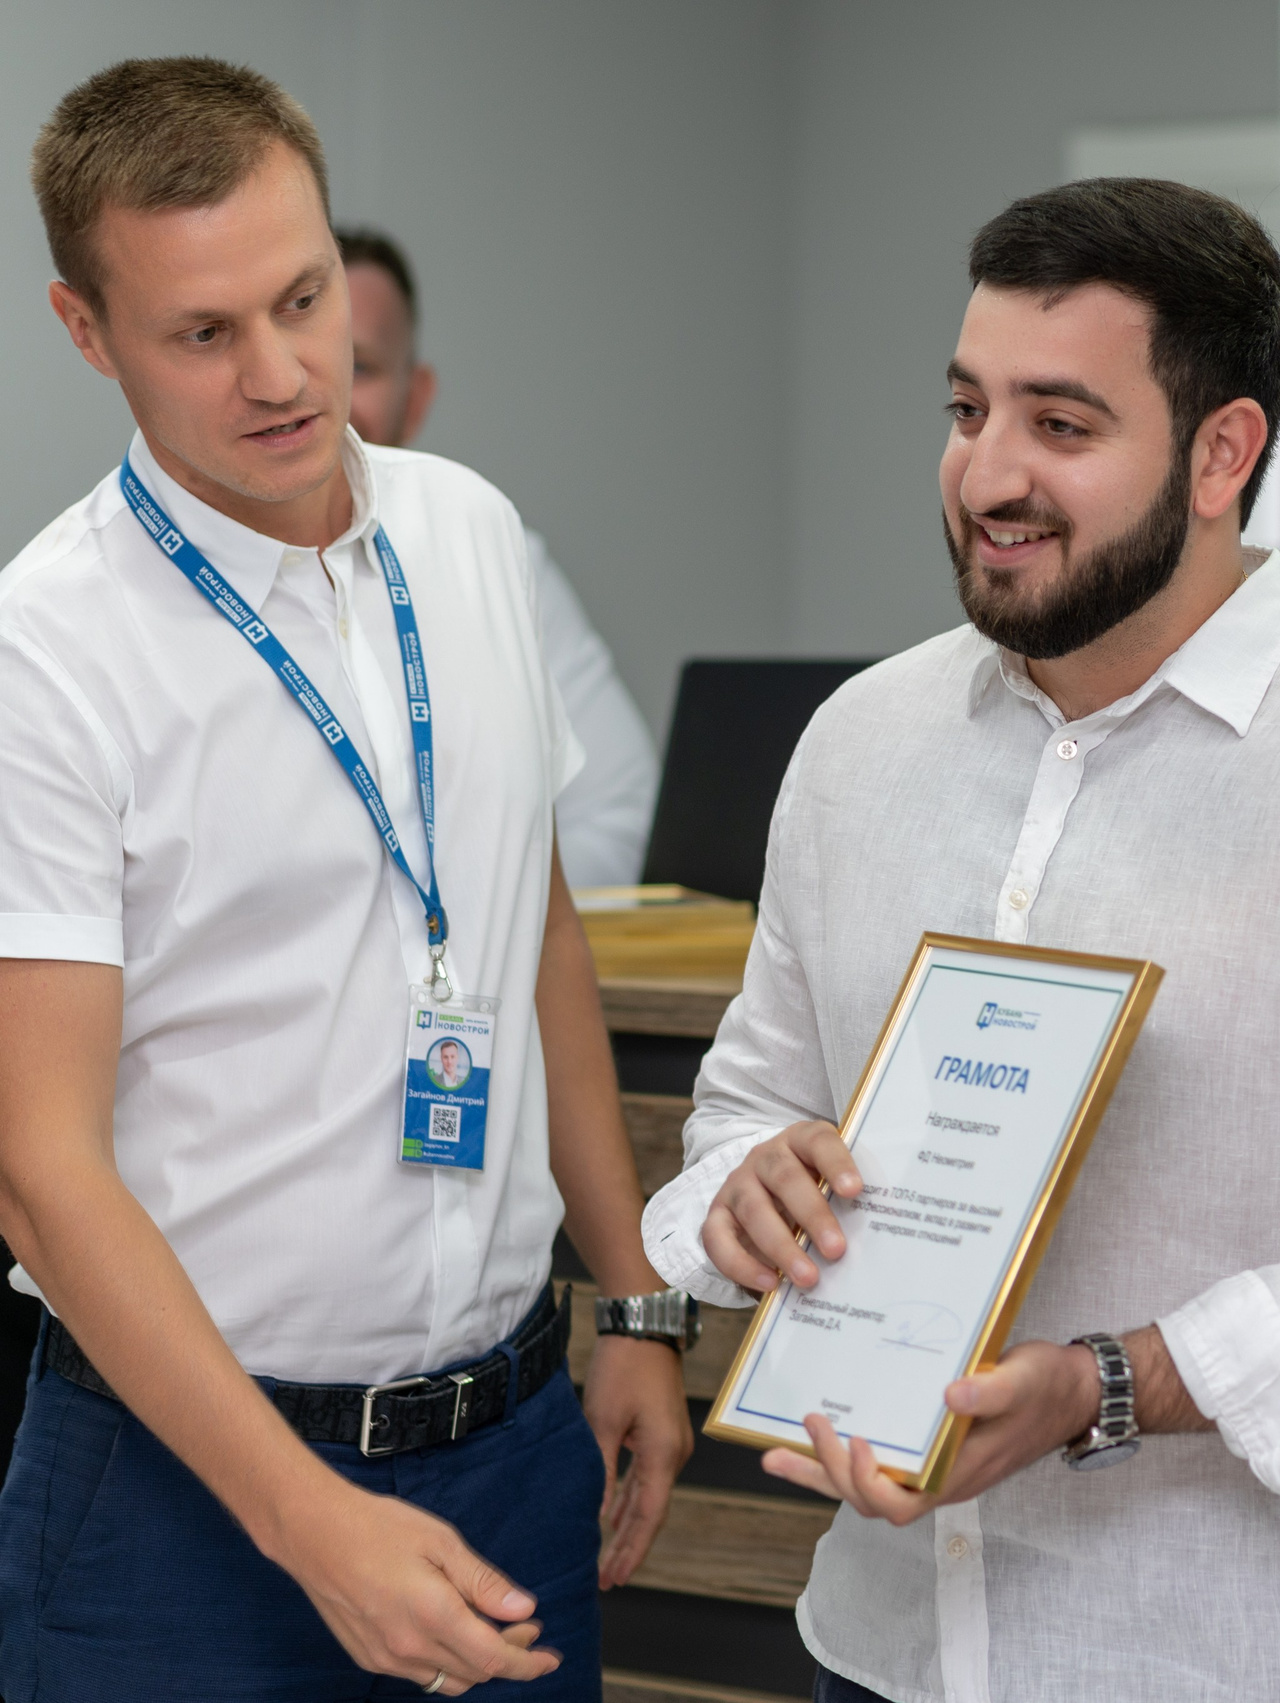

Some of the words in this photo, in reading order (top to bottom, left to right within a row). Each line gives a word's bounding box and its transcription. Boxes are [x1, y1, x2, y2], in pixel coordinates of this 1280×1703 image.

[126, 476, 165, 528] НОВОСТРОЙ
[199, 566, 249, 619] НОВОСТРОЙ
[407, 632, 425, 695] НОВОСТРОЙ
[283, 660, 329, 717] НОВОСТРОЙ
[355, 764, 390, 824] НОВОСТРОЙ
[933, 1054, 1030, 1094] ГРАМОТА
[408, 1088, 446, 1101] Загайнов
[446, 1094, 485, 1106] Дмитрий
[925, 1110, 1001, 1136] Награждается
[862, 1183, 883, 1196] одит
[891, 1186, 917, 1202] ТОП-5
[789, 1309, 826, 1328] Загайнов
[796, 1292, 850, 1315] Генеральный
